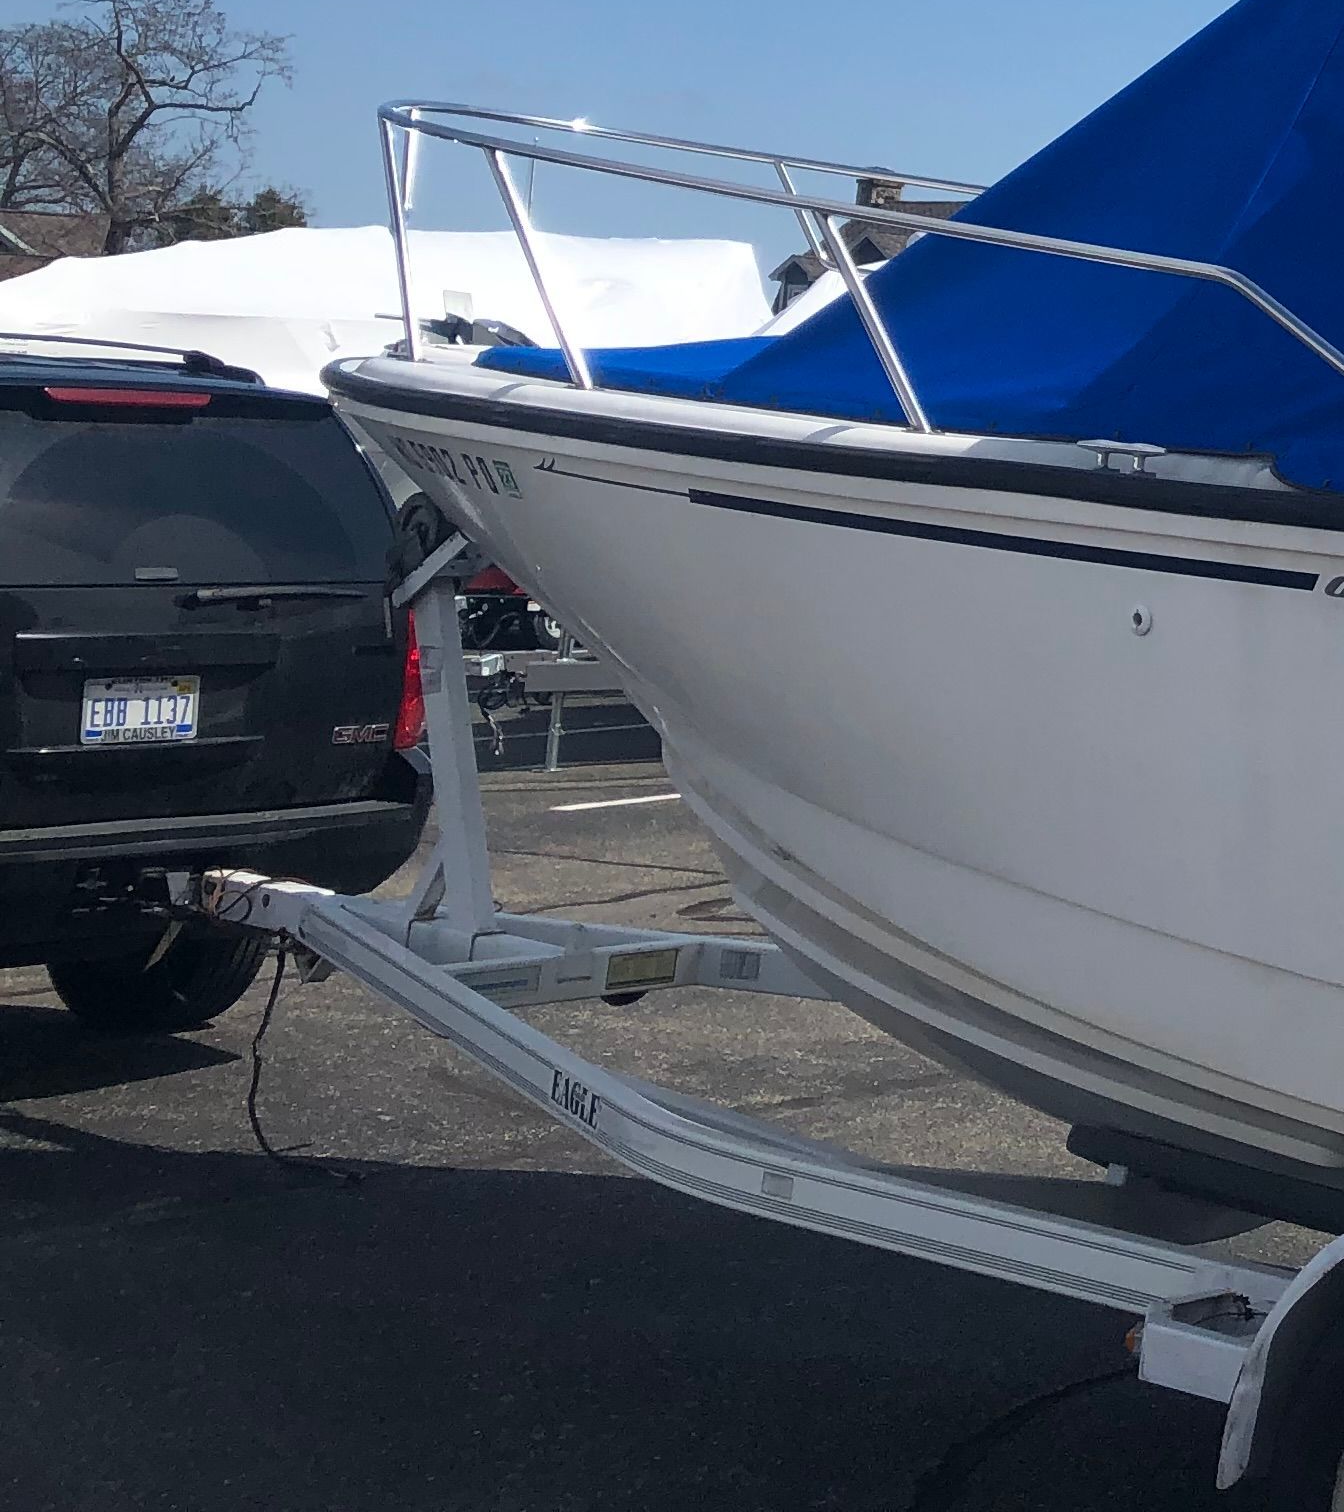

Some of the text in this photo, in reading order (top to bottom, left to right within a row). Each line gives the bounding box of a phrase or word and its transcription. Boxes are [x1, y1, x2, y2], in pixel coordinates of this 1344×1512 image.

[90, 695, 190, 728] EBB 1137
[101, 726, 175, 741] JIM CAUSLEY
[332, 723, 390, 744] GMC
[550, 1069, 601, 1130] EAGLE
